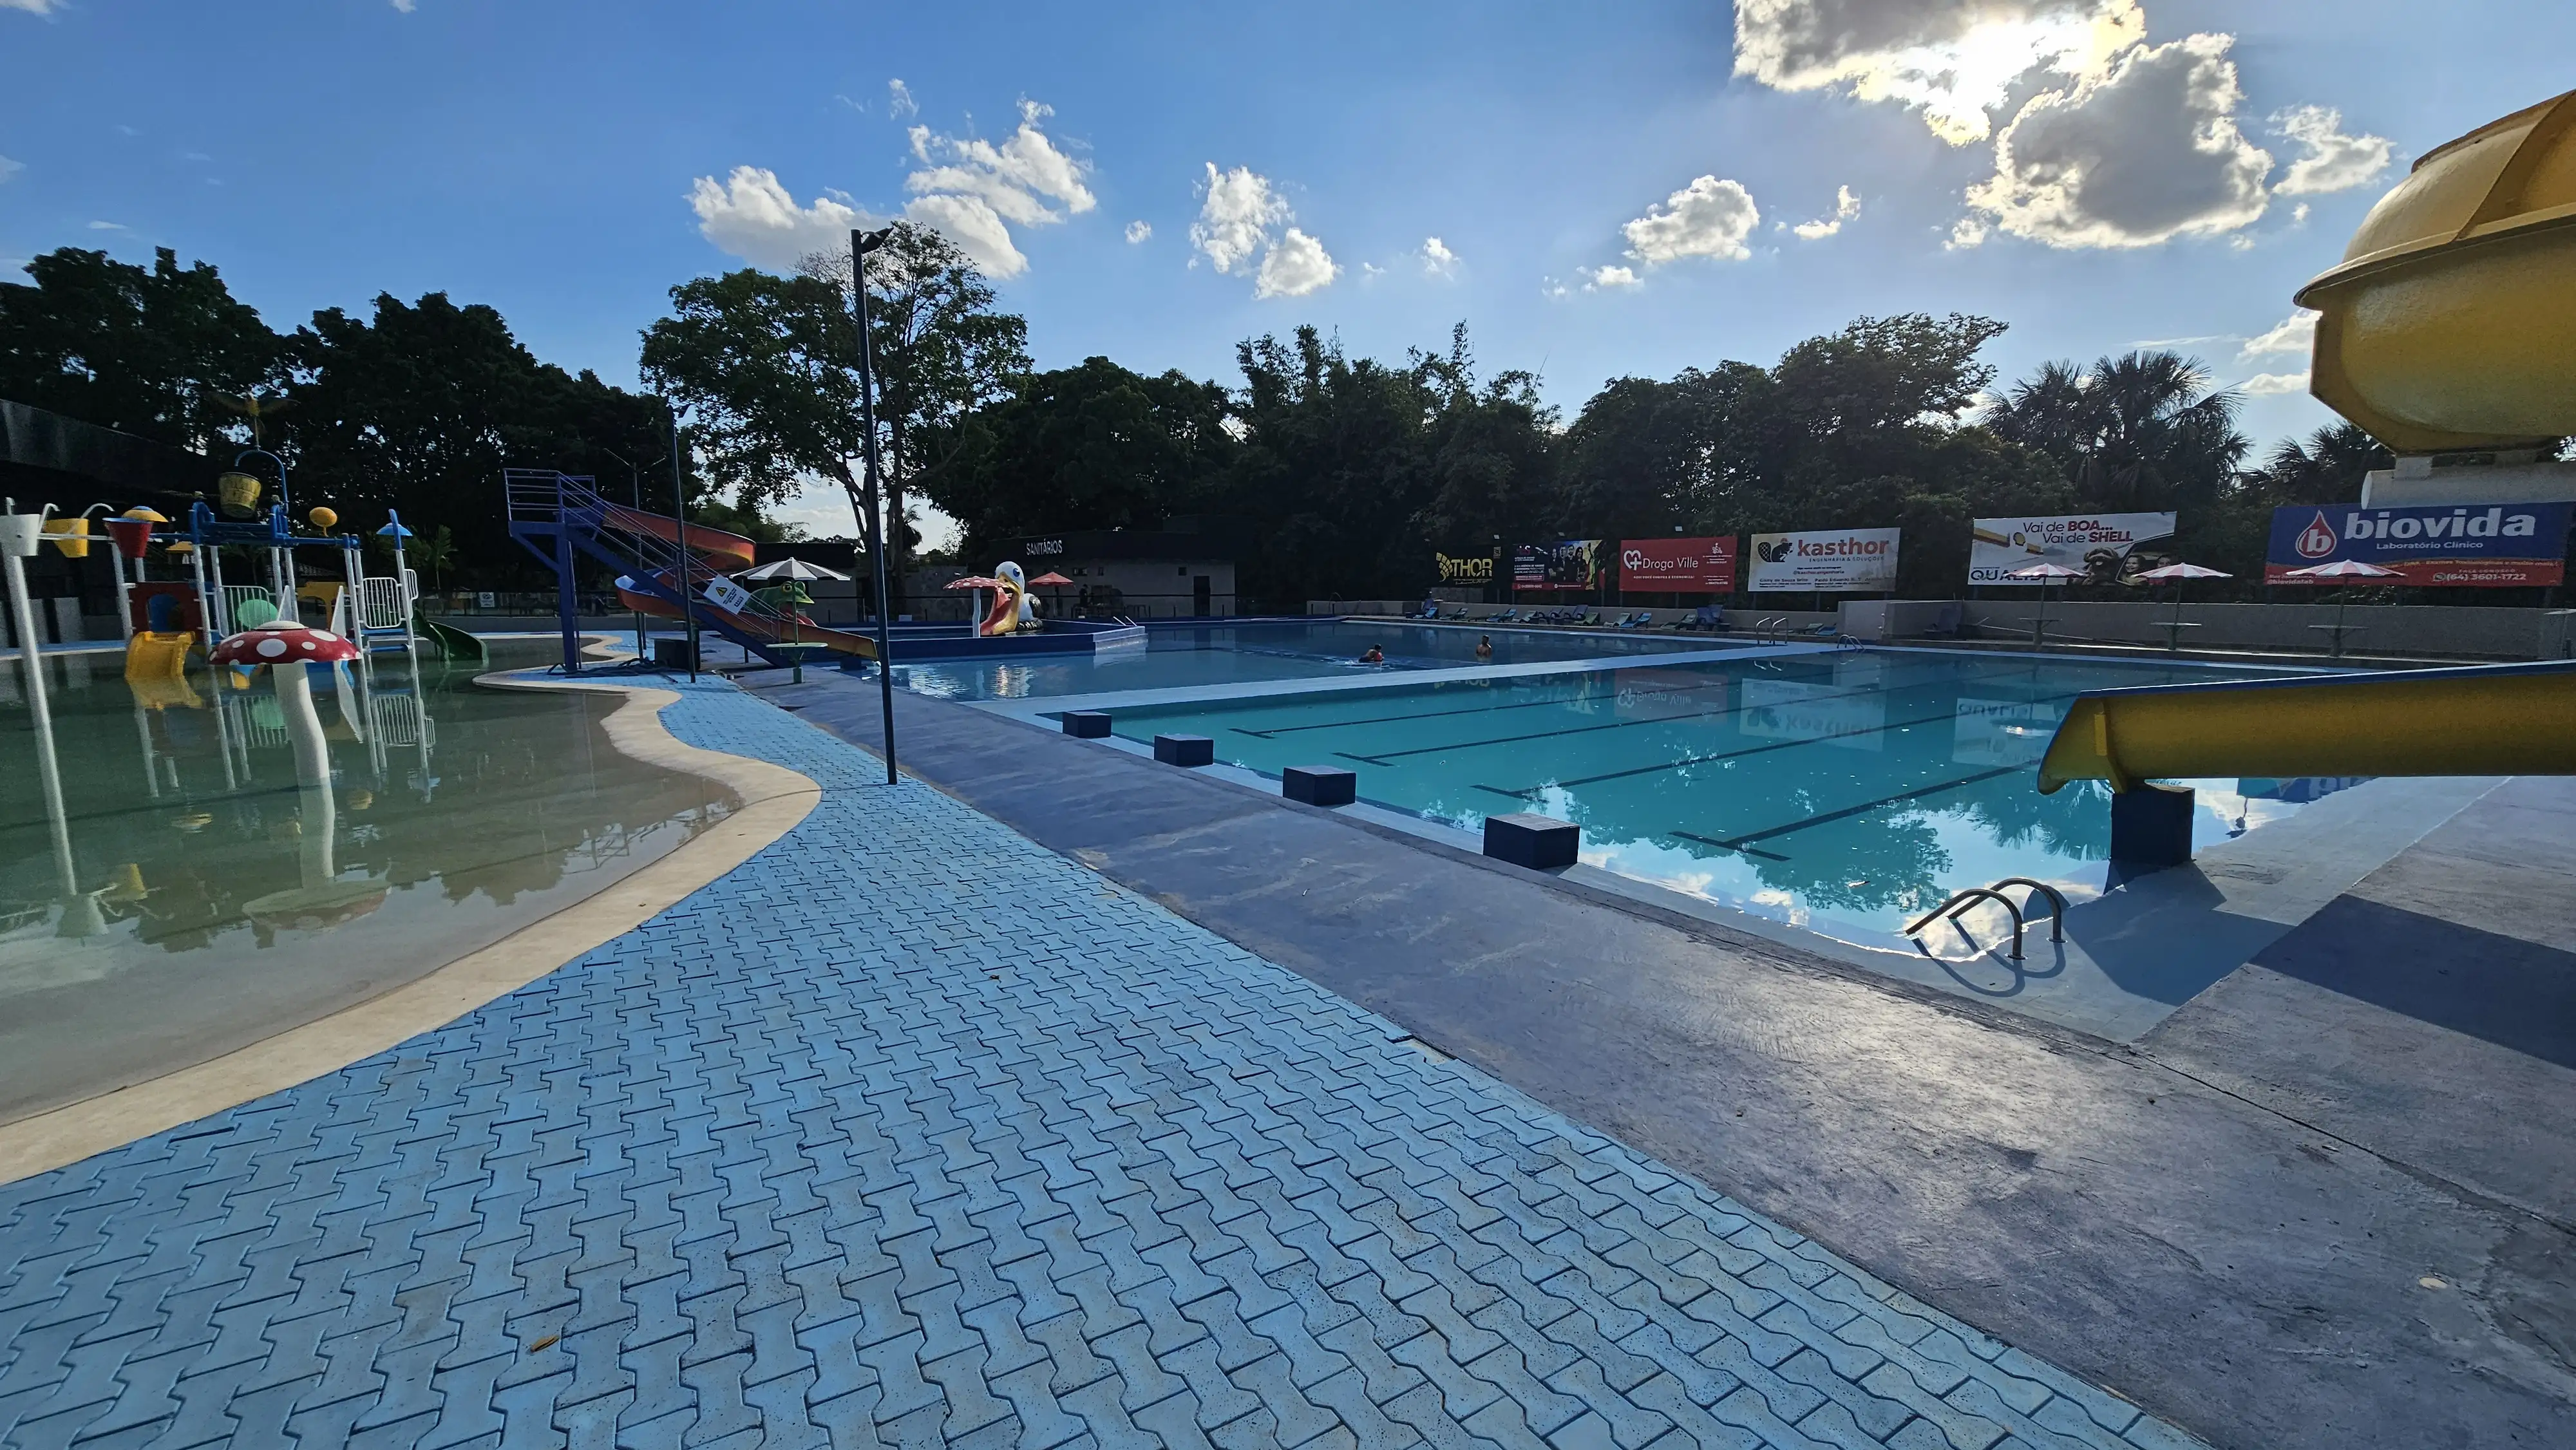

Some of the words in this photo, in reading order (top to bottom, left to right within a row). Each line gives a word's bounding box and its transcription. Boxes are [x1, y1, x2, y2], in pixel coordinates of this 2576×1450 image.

[2023, 522, 2043, 533] Vai
[2046, 522, 2065, 532] de
[2068, 520, 2113, 531] BOA...
[2344, 507, 2535, 540] biovida
[2043, 532, 2063, 543] Vai
[2067, 532, 2085, 543] de
[2088, 531, 2134, 542] SHELL
[1026, 538, 1063, 555] SANITÁRIOS
[1797, 537, 1889, 556] kasthor
[1451, 558, 1493, 577] THOR
[1643, 558, 1674, 570] Droga
[1677, 557, 1699, 568] Ville
